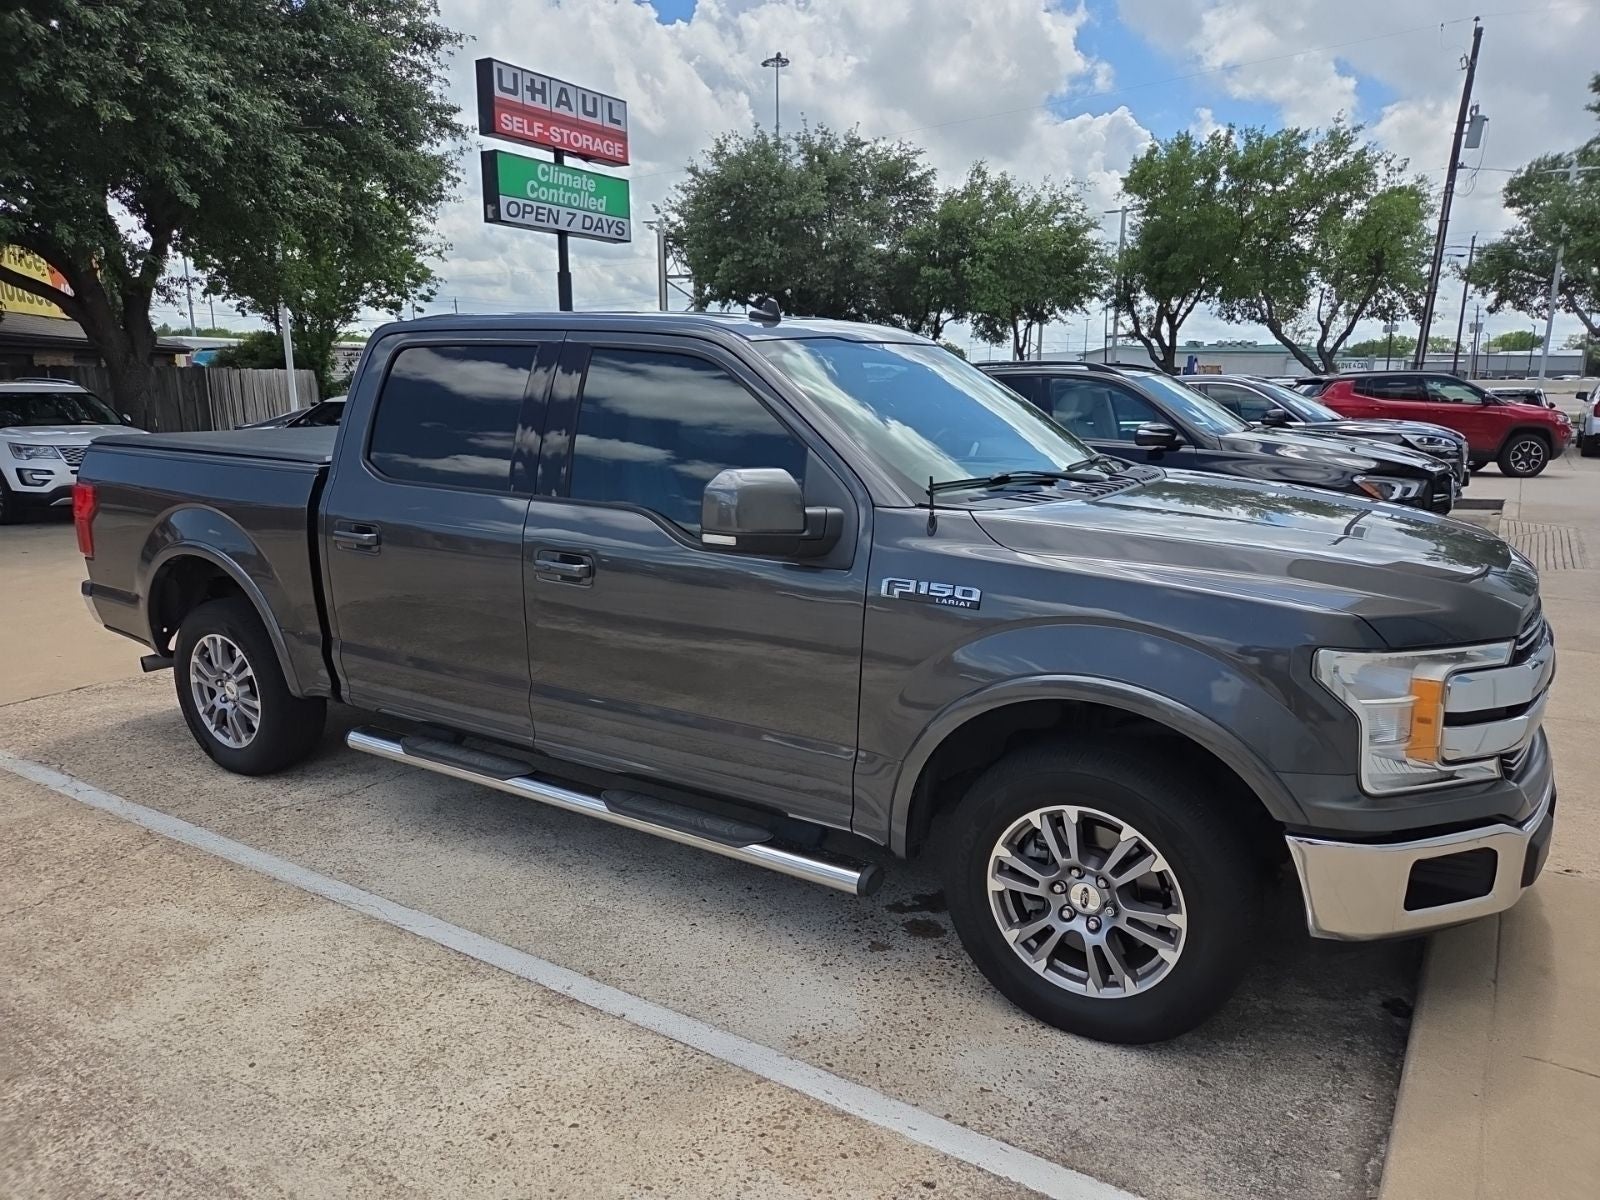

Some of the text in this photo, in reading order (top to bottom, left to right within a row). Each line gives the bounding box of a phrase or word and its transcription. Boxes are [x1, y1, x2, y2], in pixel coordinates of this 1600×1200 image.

[500, 113, 624, 158] SELF-STORAGE
[537, 163, 597, 193] Climate
[526, 180, 607, 212] Controlled
[506, 201, 626, 237] OPEN 7 DAYS
[935, 598, 971, 607] LARIAT
